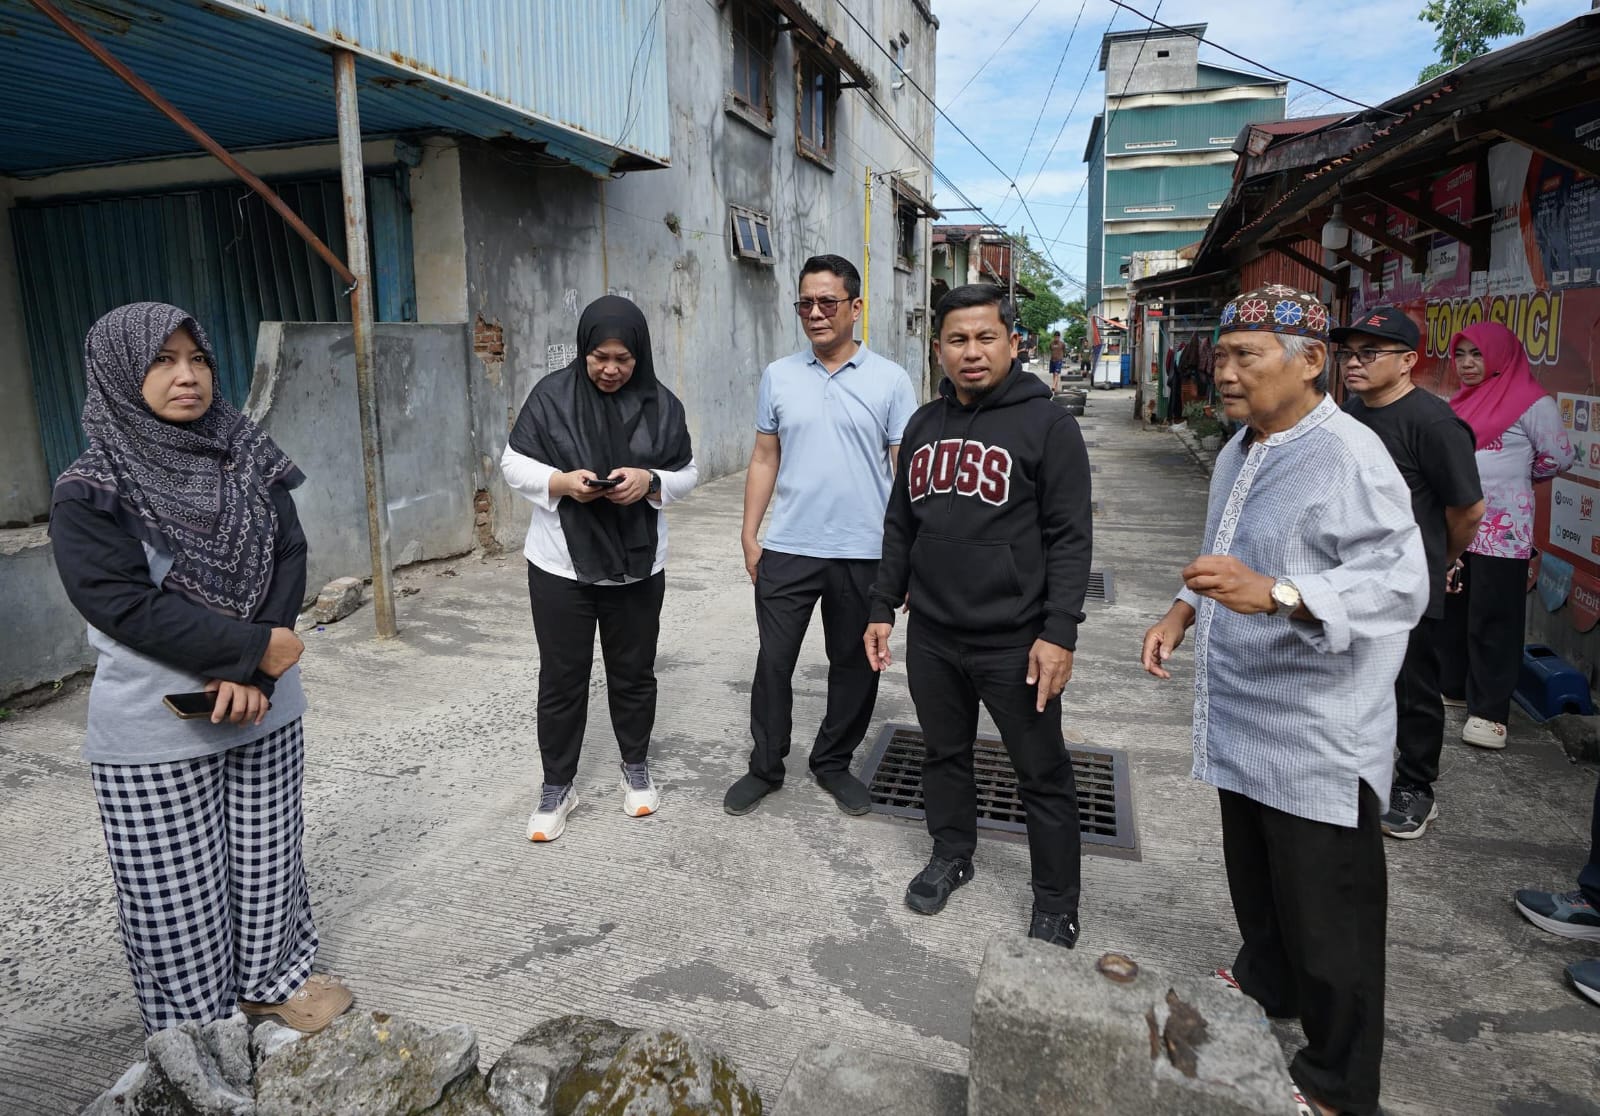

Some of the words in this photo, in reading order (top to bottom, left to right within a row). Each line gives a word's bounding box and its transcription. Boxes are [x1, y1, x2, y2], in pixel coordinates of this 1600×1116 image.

[908, 438, 1013, 507] BOSS
[1561, 528, 1581, 545] gopay
[1574, 585, 1600, 611] Orbit
